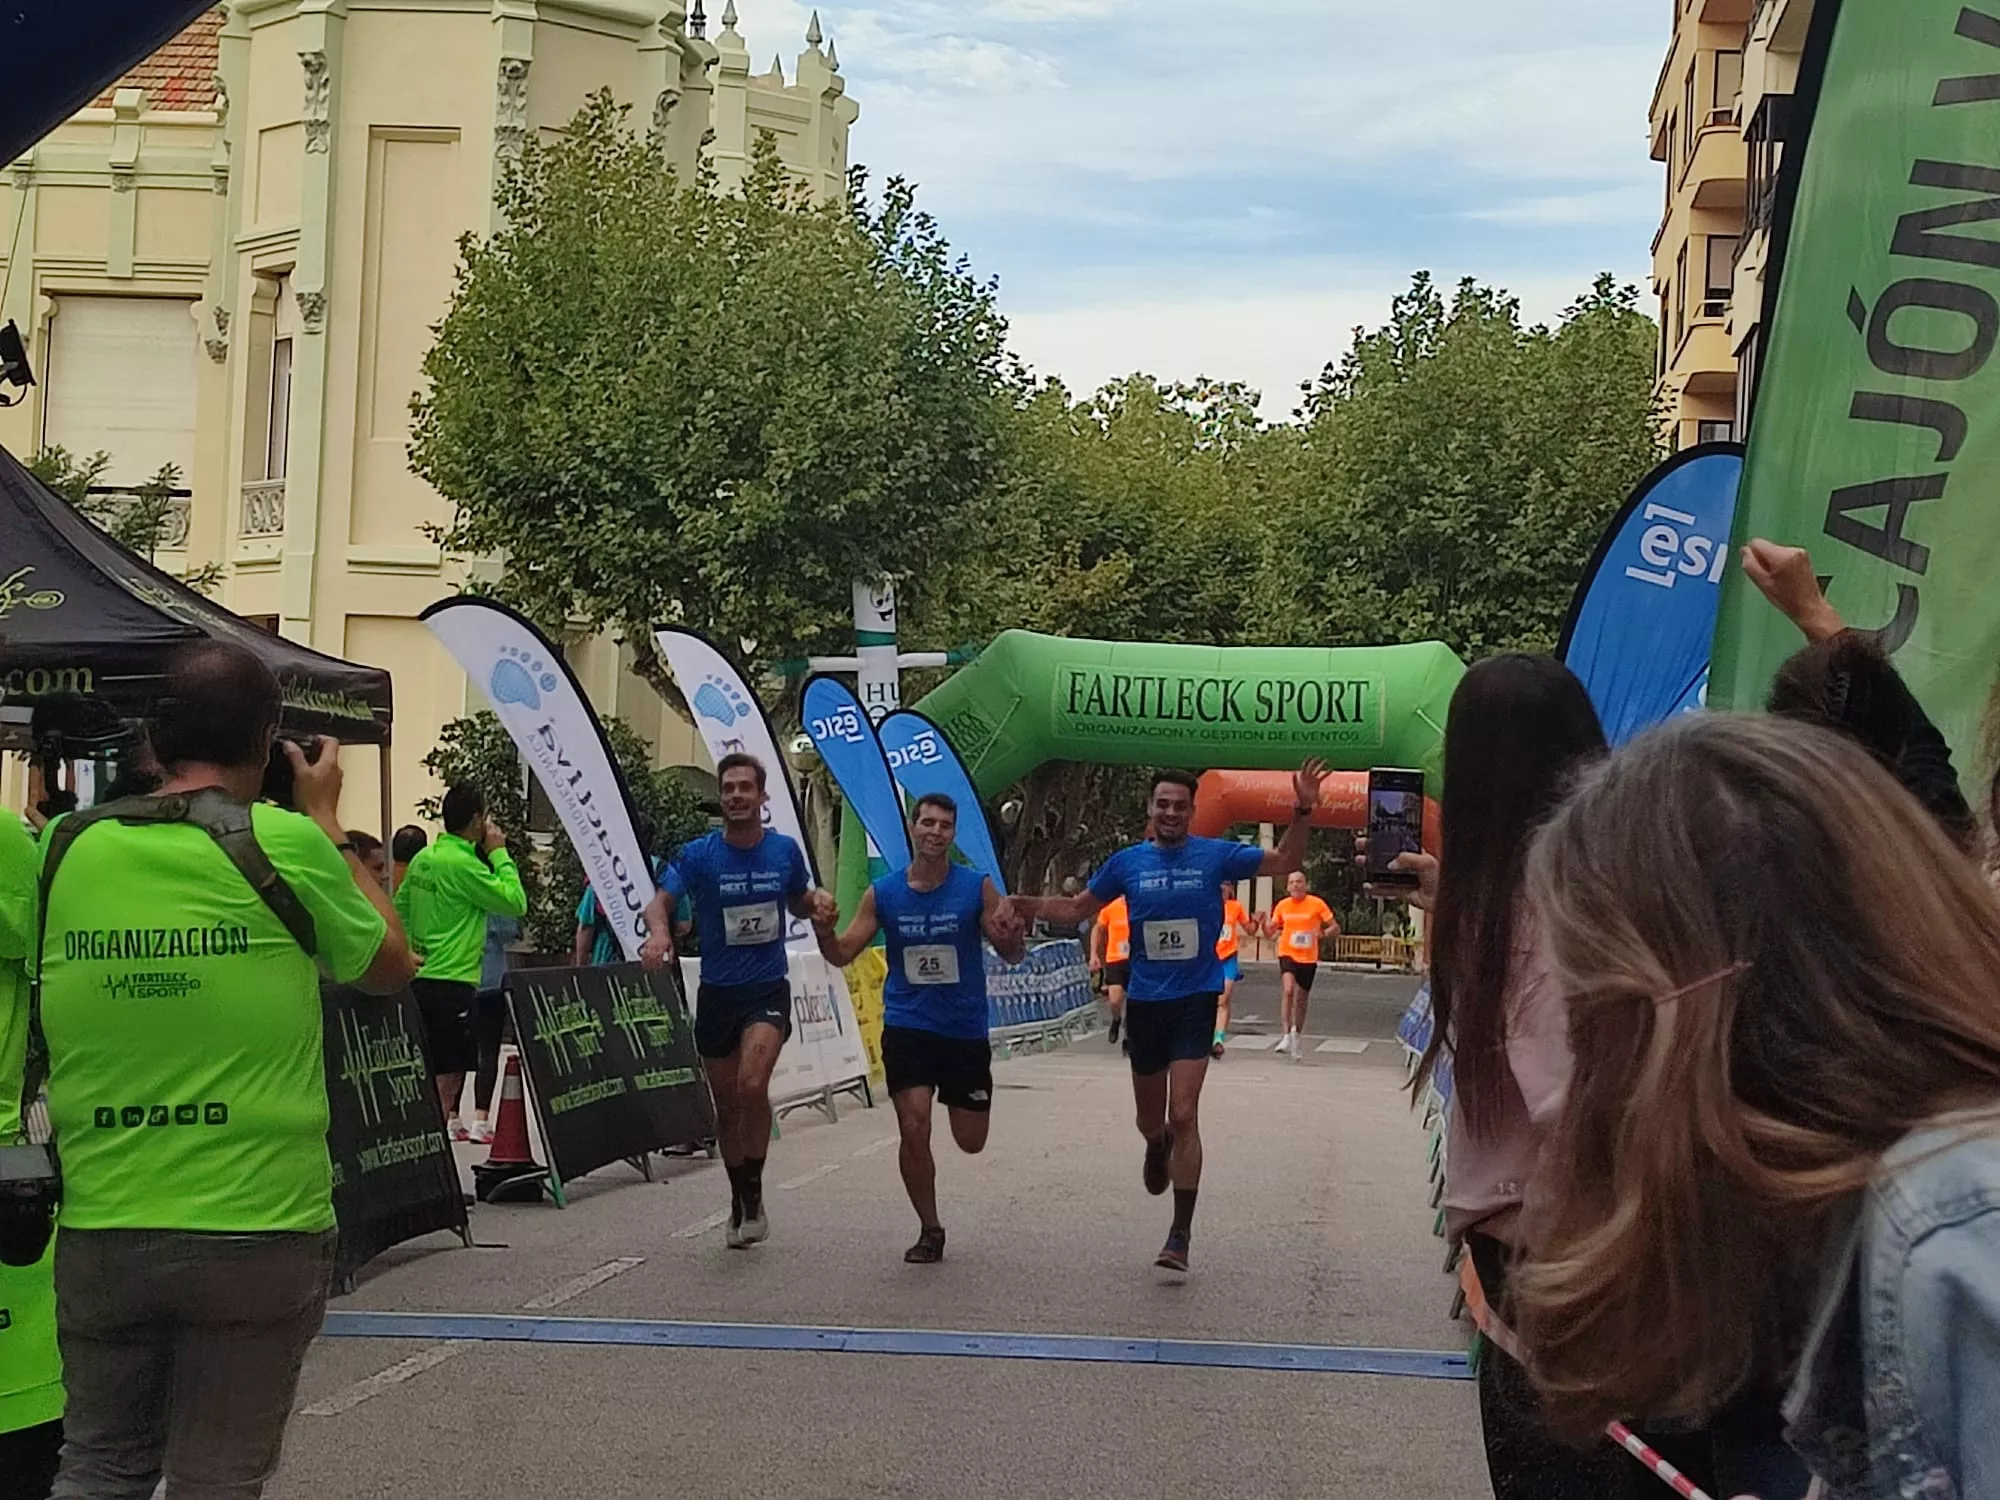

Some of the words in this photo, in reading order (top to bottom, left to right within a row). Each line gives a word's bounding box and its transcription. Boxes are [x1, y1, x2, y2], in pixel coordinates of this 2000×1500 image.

[1066, 671, 1246, 723] FARTLECK
[1255, 679, 1370, 724] SPORT
[1268, 731, 1285, 741] DE
[740, 917, 762, 932] 27
[65, 920, 249, 960] ORGANIZACIÓN
[1158, 930, 1181, 945] 26
[919, 957, 940, 971] 25
[137, 987, 188, 999] SPORT
